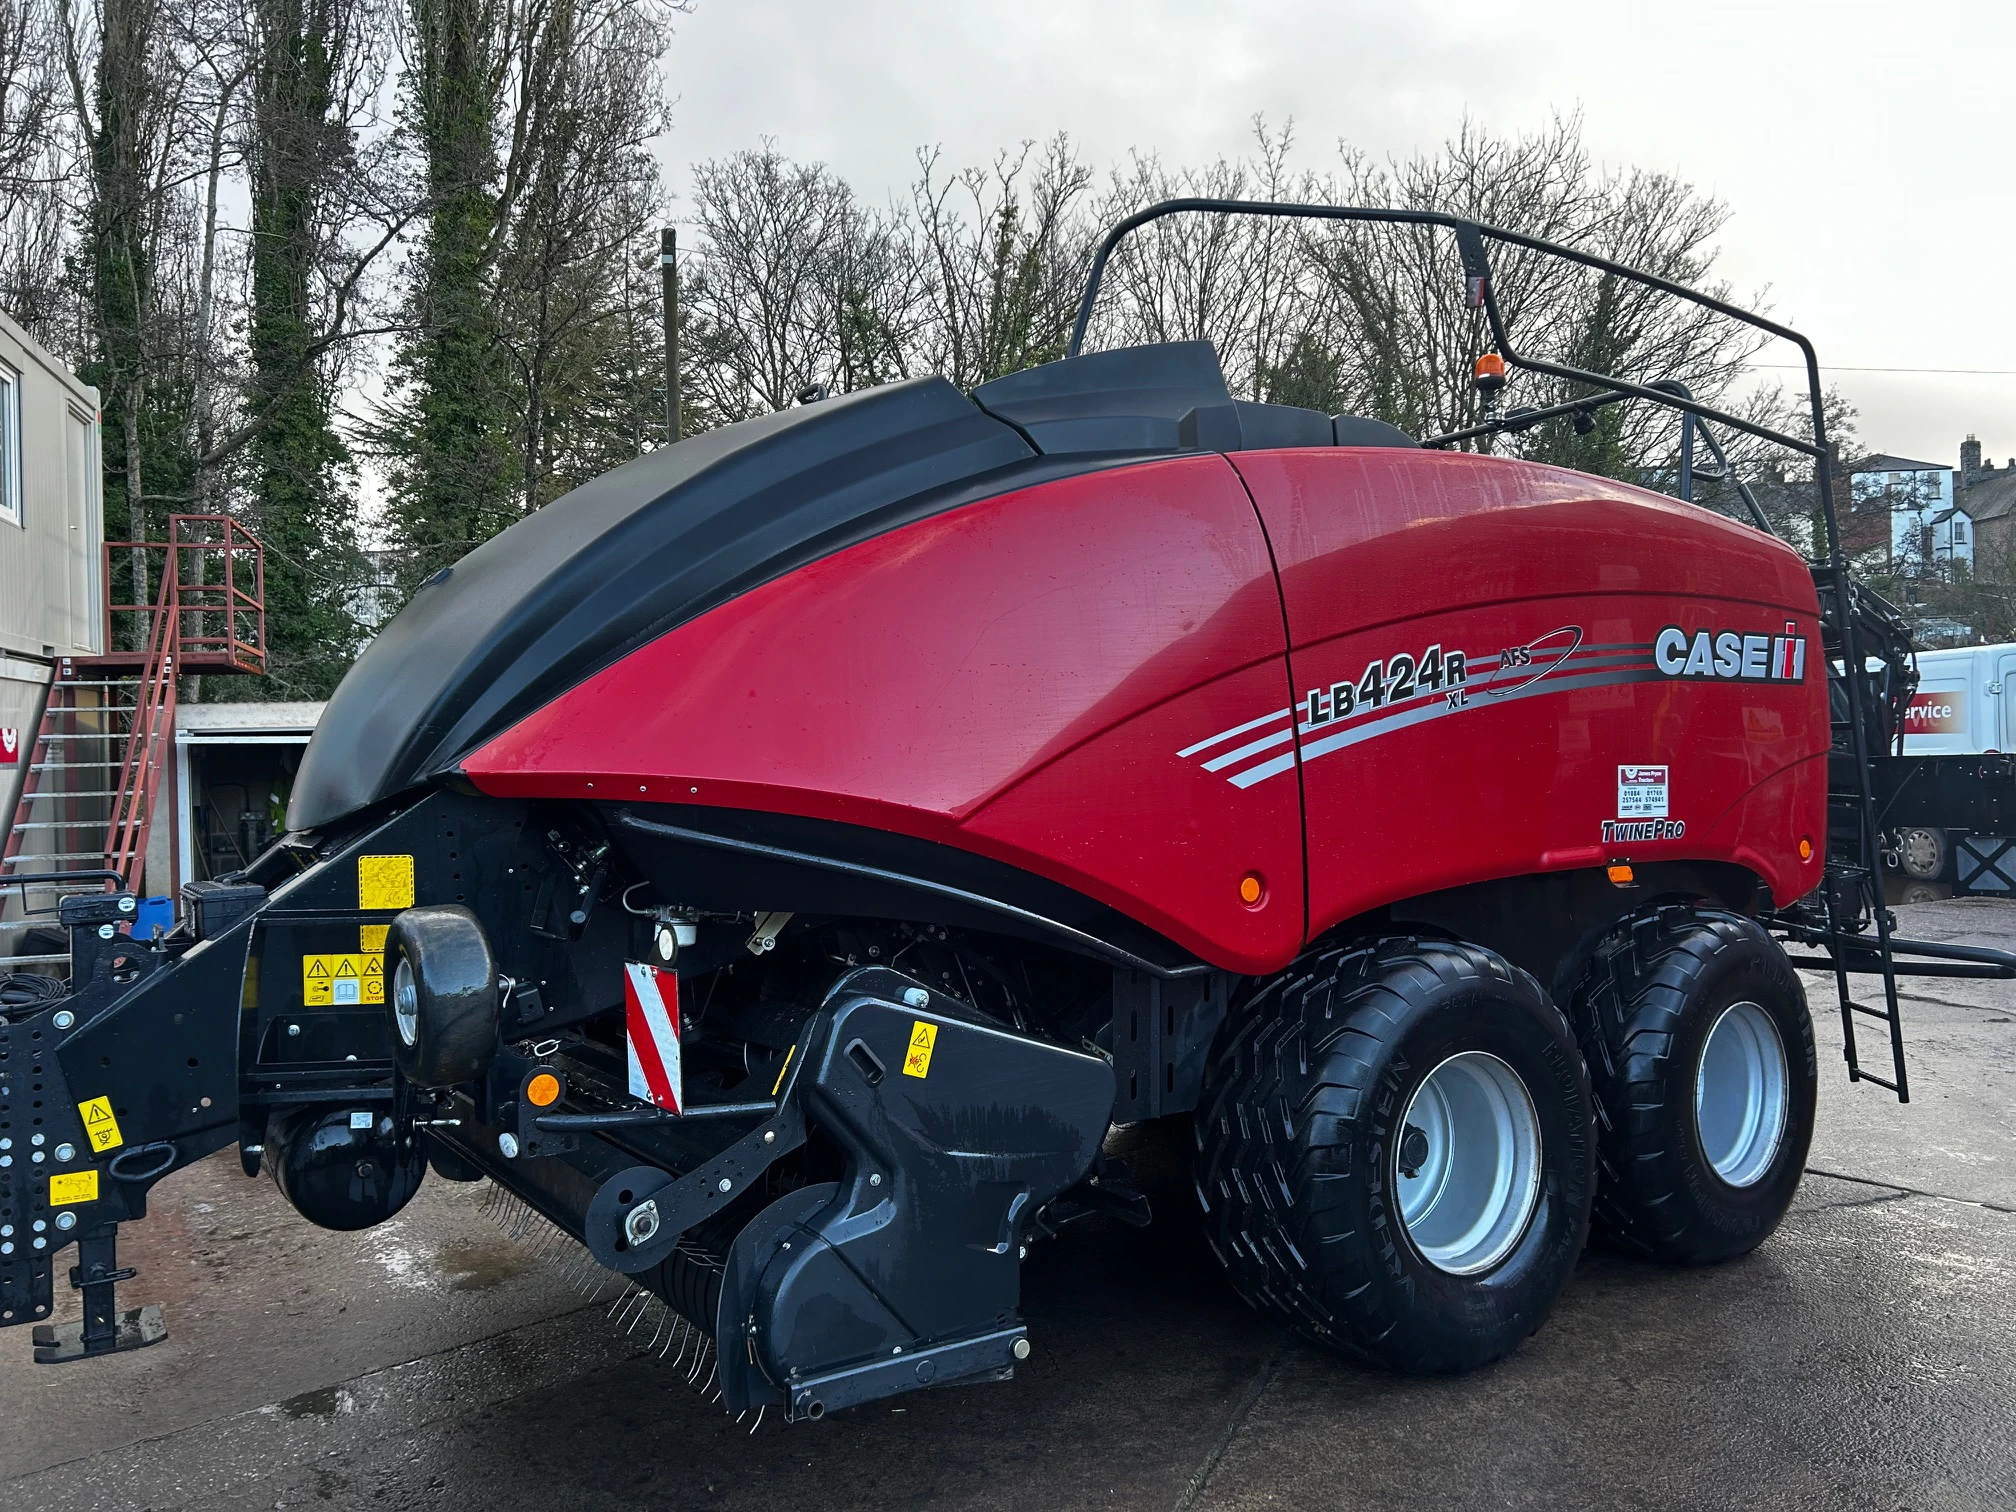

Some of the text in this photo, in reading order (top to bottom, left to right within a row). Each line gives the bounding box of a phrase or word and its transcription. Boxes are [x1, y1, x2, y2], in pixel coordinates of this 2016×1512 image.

[1499, 645, 1531, 669] AFS
[1655, 625, 1769, 679] CASE
[1306, 643, 1469, 729] LB424R
[1445, 691, 1470, 713] XL
[1904, 700, 1952, 720] ervice
